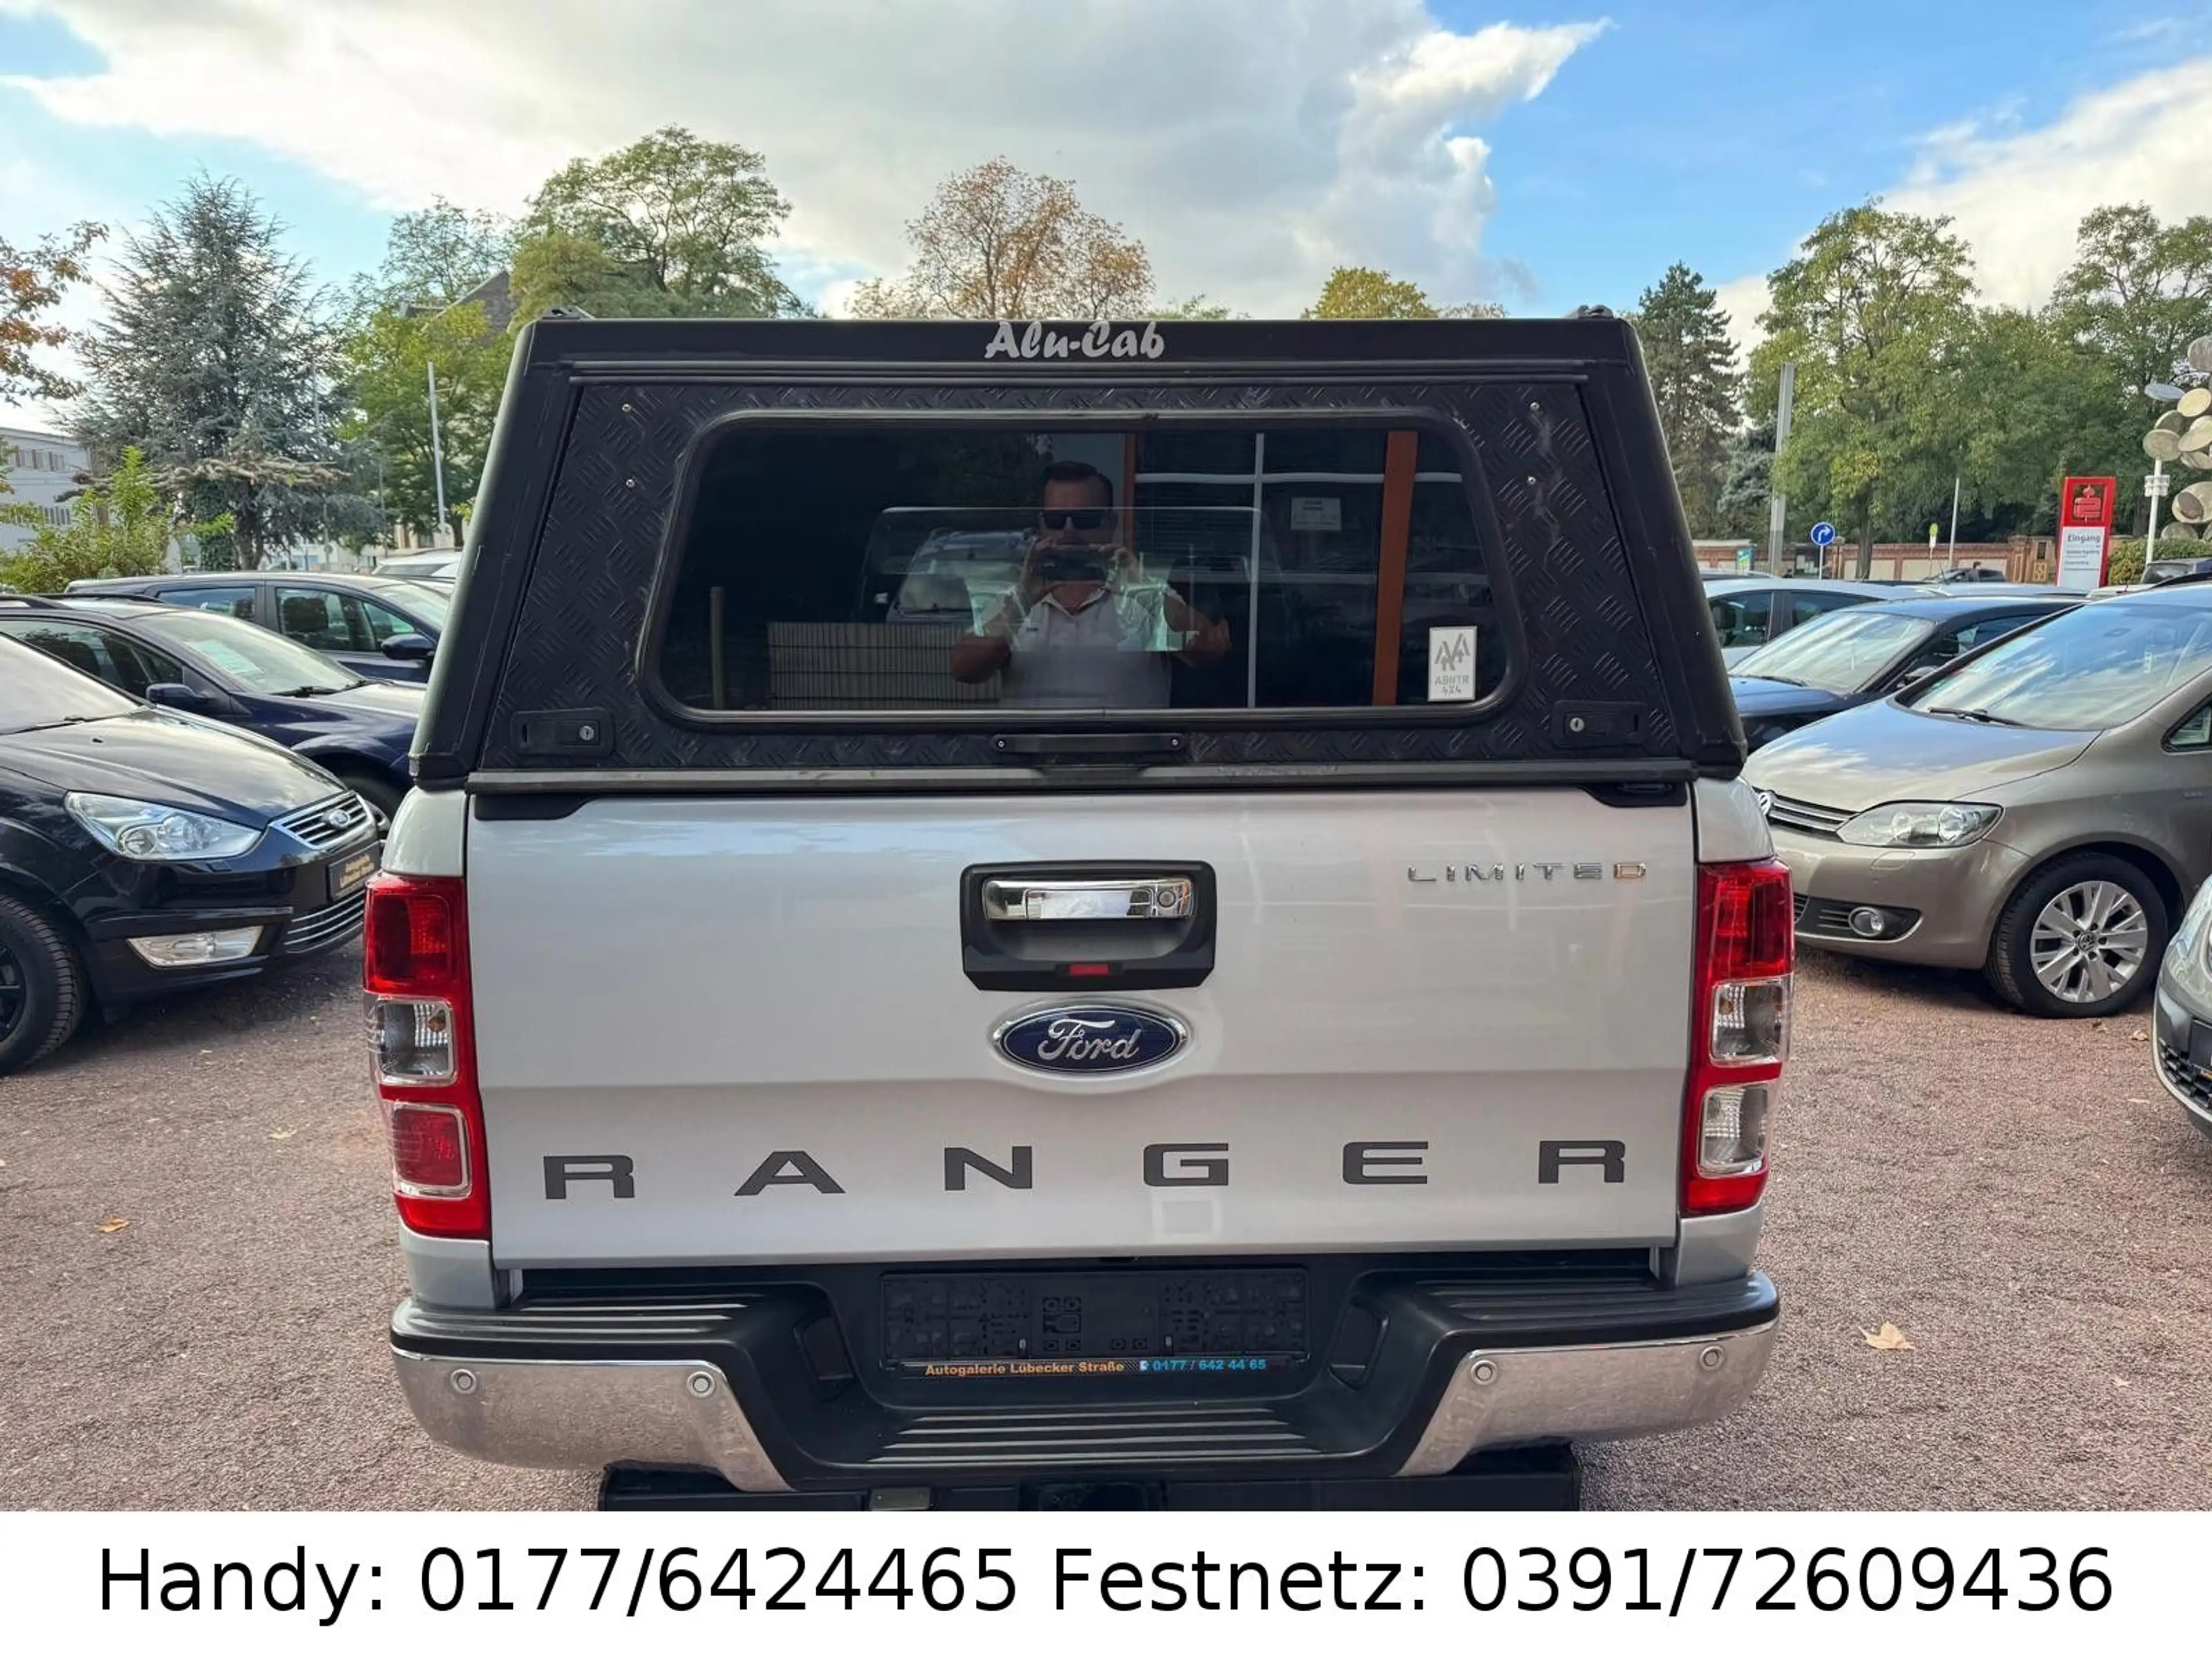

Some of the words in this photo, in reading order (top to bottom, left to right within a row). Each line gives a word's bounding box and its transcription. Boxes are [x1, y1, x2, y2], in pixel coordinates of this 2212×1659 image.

[984, 320, 1165, 359] Alu-Cab
[2068, 535, 2100, 543] Eingang
[1407, 862, 1647, 882] LIMITED
[1037, 1018, 1142, 1061] Ford
[543, 1140, 1626, 1200] RANGER
[925, 1363, 1007, 1377] Autogalerie
[1010, 1362, 1074, 1374] Lübecker
[1078, 1362, 1124, 1373] Straße
[1152, 1360, 1187, 1370] 0177
[1198, 1359, 1224, 1370] 642
[1228, 1359, 1245, 1370] 44
[1249, 1359, 1267, 1370] 65
